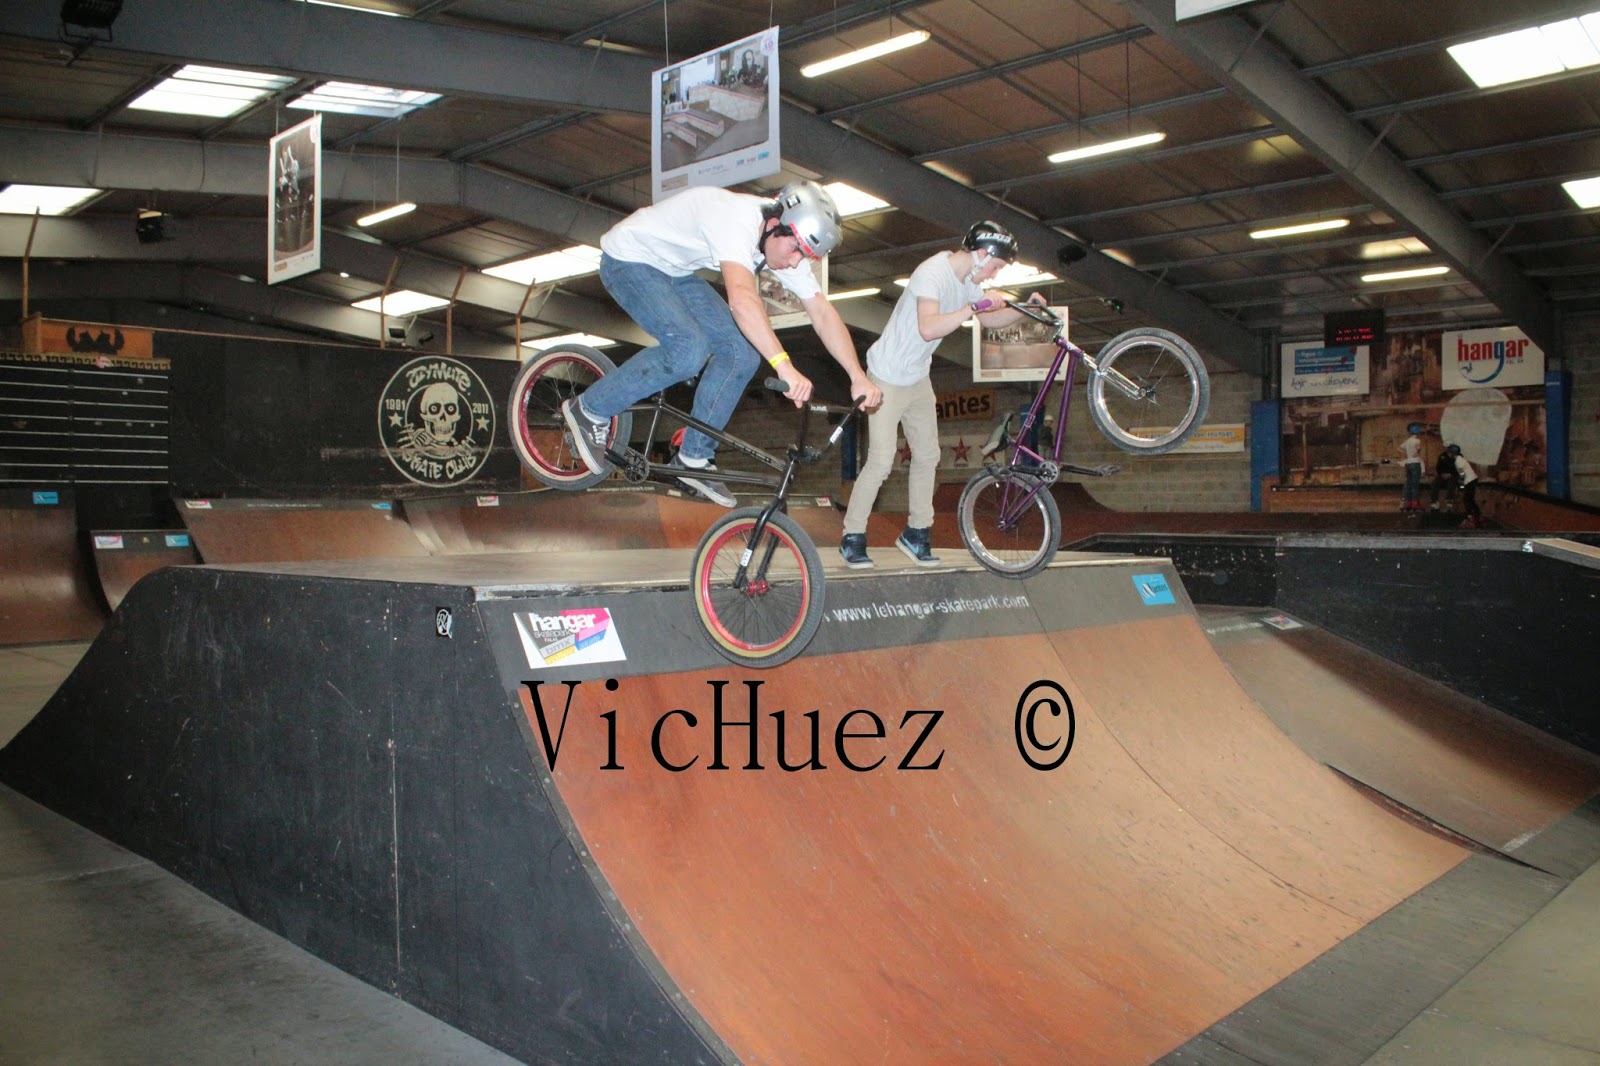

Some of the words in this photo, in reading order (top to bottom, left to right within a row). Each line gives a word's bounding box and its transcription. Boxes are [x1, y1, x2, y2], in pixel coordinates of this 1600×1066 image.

[472, 402, 489, 414] 2011
[936, 394, 990, 419] antes
[446, 453, 477, 479] CLUB
[528, 612, 596, 633] hangar
[545, 638, 571, 655] bmx
